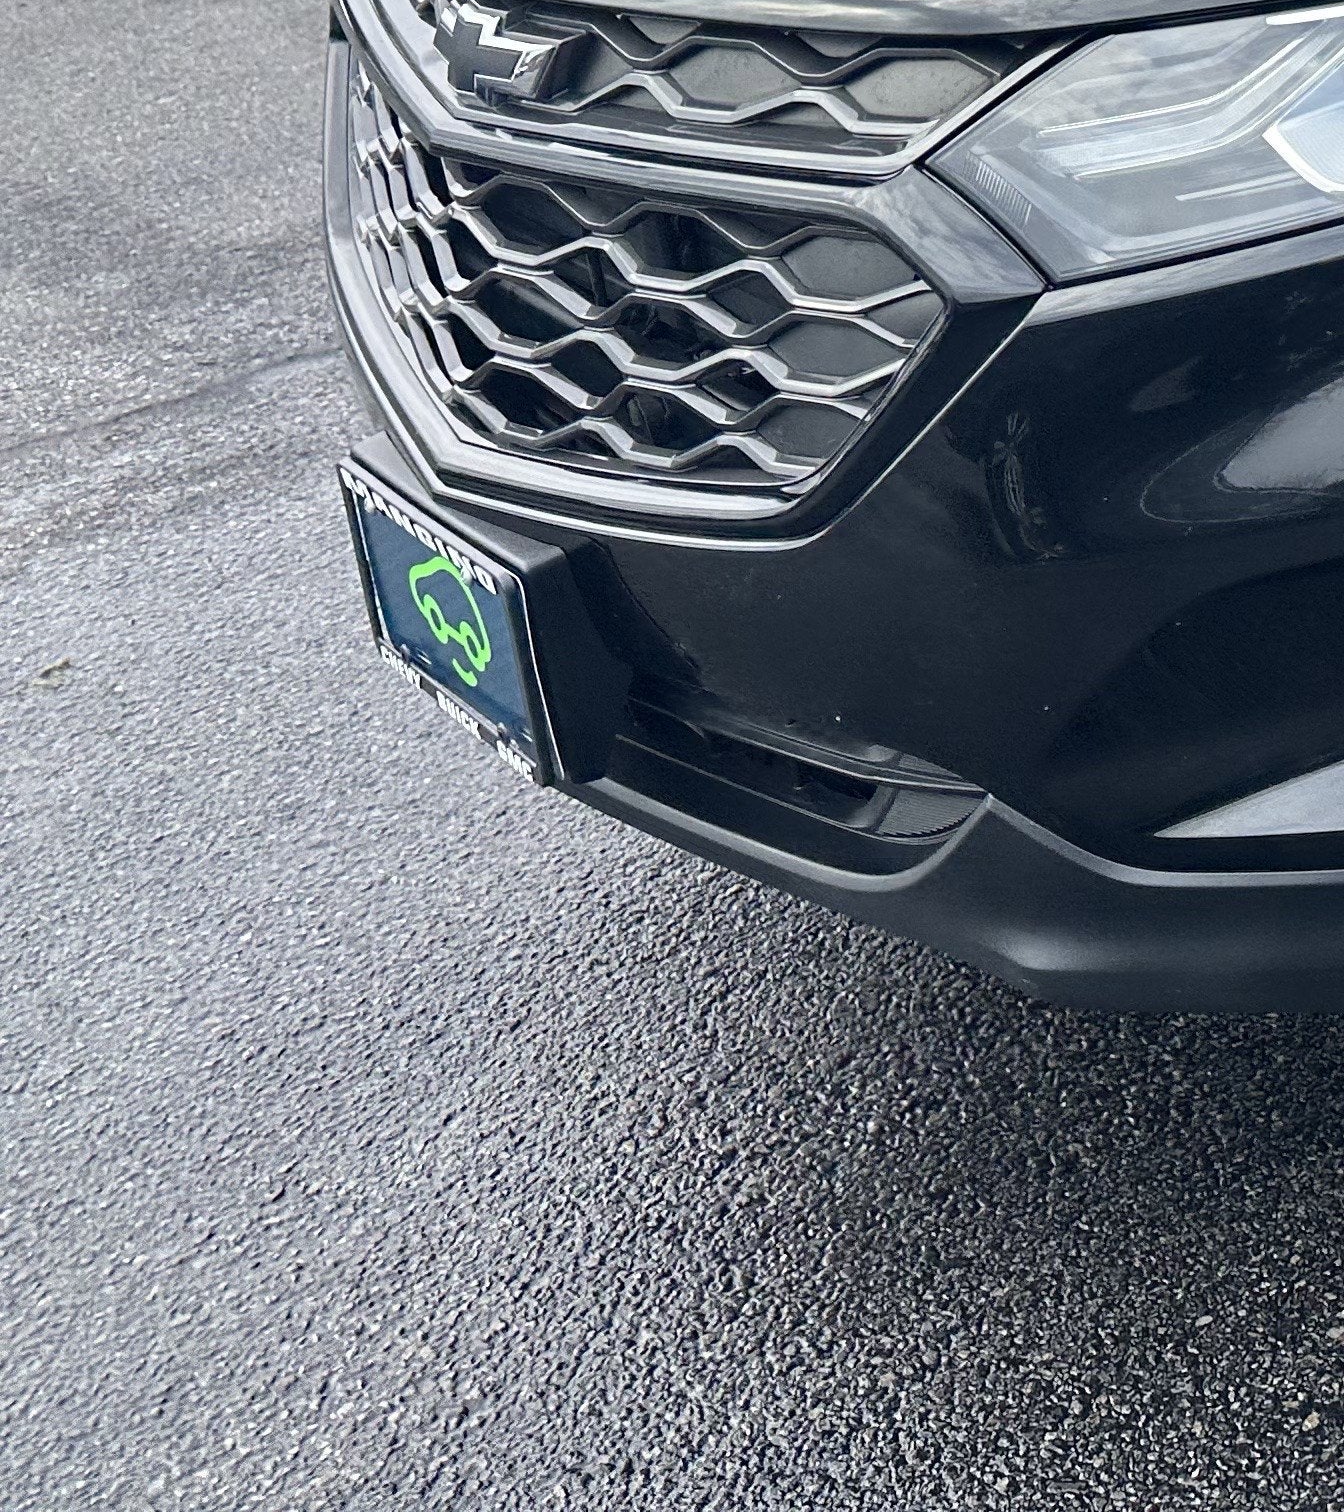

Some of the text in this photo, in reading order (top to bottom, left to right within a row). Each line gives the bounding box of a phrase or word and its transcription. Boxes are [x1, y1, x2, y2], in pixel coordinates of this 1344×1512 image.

[380, 645, 535, 783] CHEVY BUICK GMC
